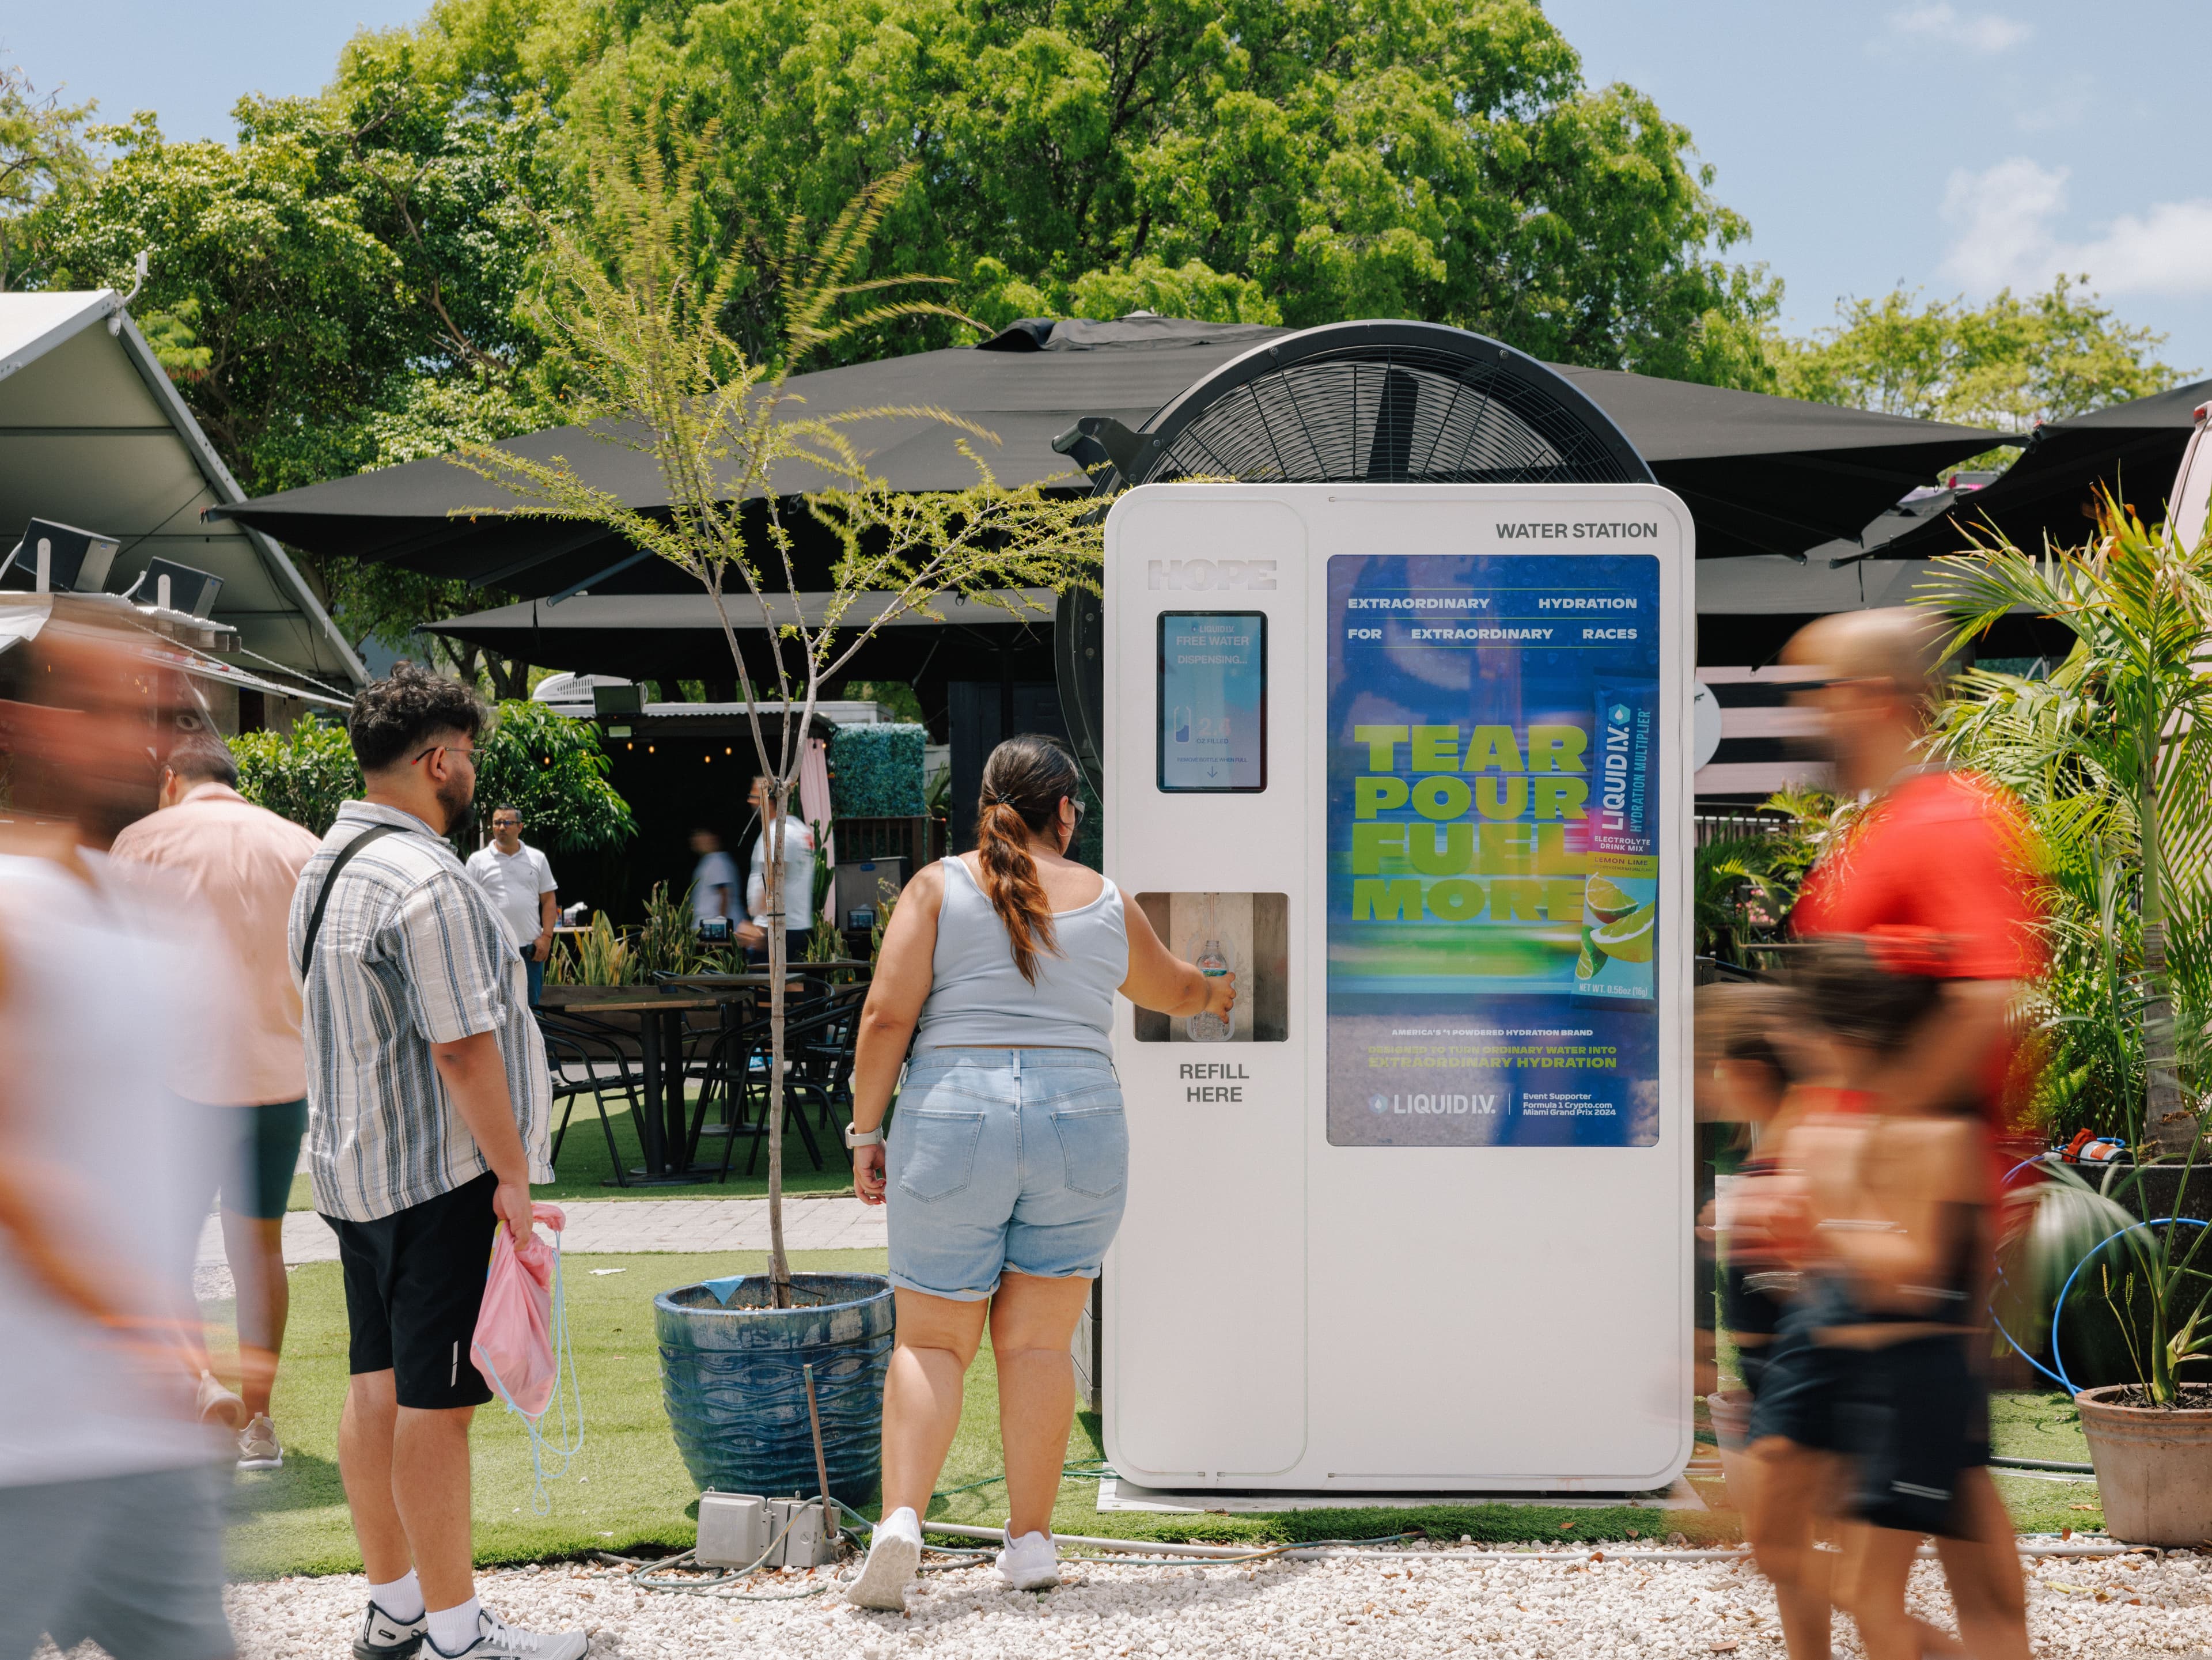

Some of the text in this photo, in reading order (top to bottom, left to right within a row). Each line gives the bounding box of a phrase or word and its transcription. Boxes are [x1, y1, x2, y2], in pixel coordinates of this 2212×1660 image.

[1496, 522, 1657, 539] WATER STATION
[1148, 559, 1277, 590] HOPE
[1348, 598, 1637, 609] EXTRAORDINARY HYDRATION
[1176, 636, 1249, 646] FREE WATER
[1348, 628, 1637, 640] FOR EXTRAORDINARY RACES
[1177, 655, 1247, 664] DISPENSING...
[1354, 725, 1588, 772] TEAR
[1601, 726, 1630, 830] LIQUID I.V.
[1630, 710, 1650, 832] HYDRATION MULTIPLIER
[1355, 776, 1589, 820] POUR
[1594, 835, 1650, 846] ELECTROLYTE
[1600, 842, 1643, 852] DRINK MIX
[1353, 823, 1586, 876] FUEL
[1352, 879, 1584, 921] MORE
[1579, 983, 1647, 997] NET WT. 0.56oz (16g)
[1368, 1046, 1616, 1054] DESIGNED TO TURN ORDINARY WATER INTO
[1368, 1057, 1616, 1067] EXTRAORDINARY HYDRATION
[1180, 1063, 1249, 1079] REFILL
[1187, 1086, 1243, 1102] HERE
[1393, 1094, 1496, 1115] LIQUID I.V.
[1565, 1102, 1612, 1110] Crypto.com
